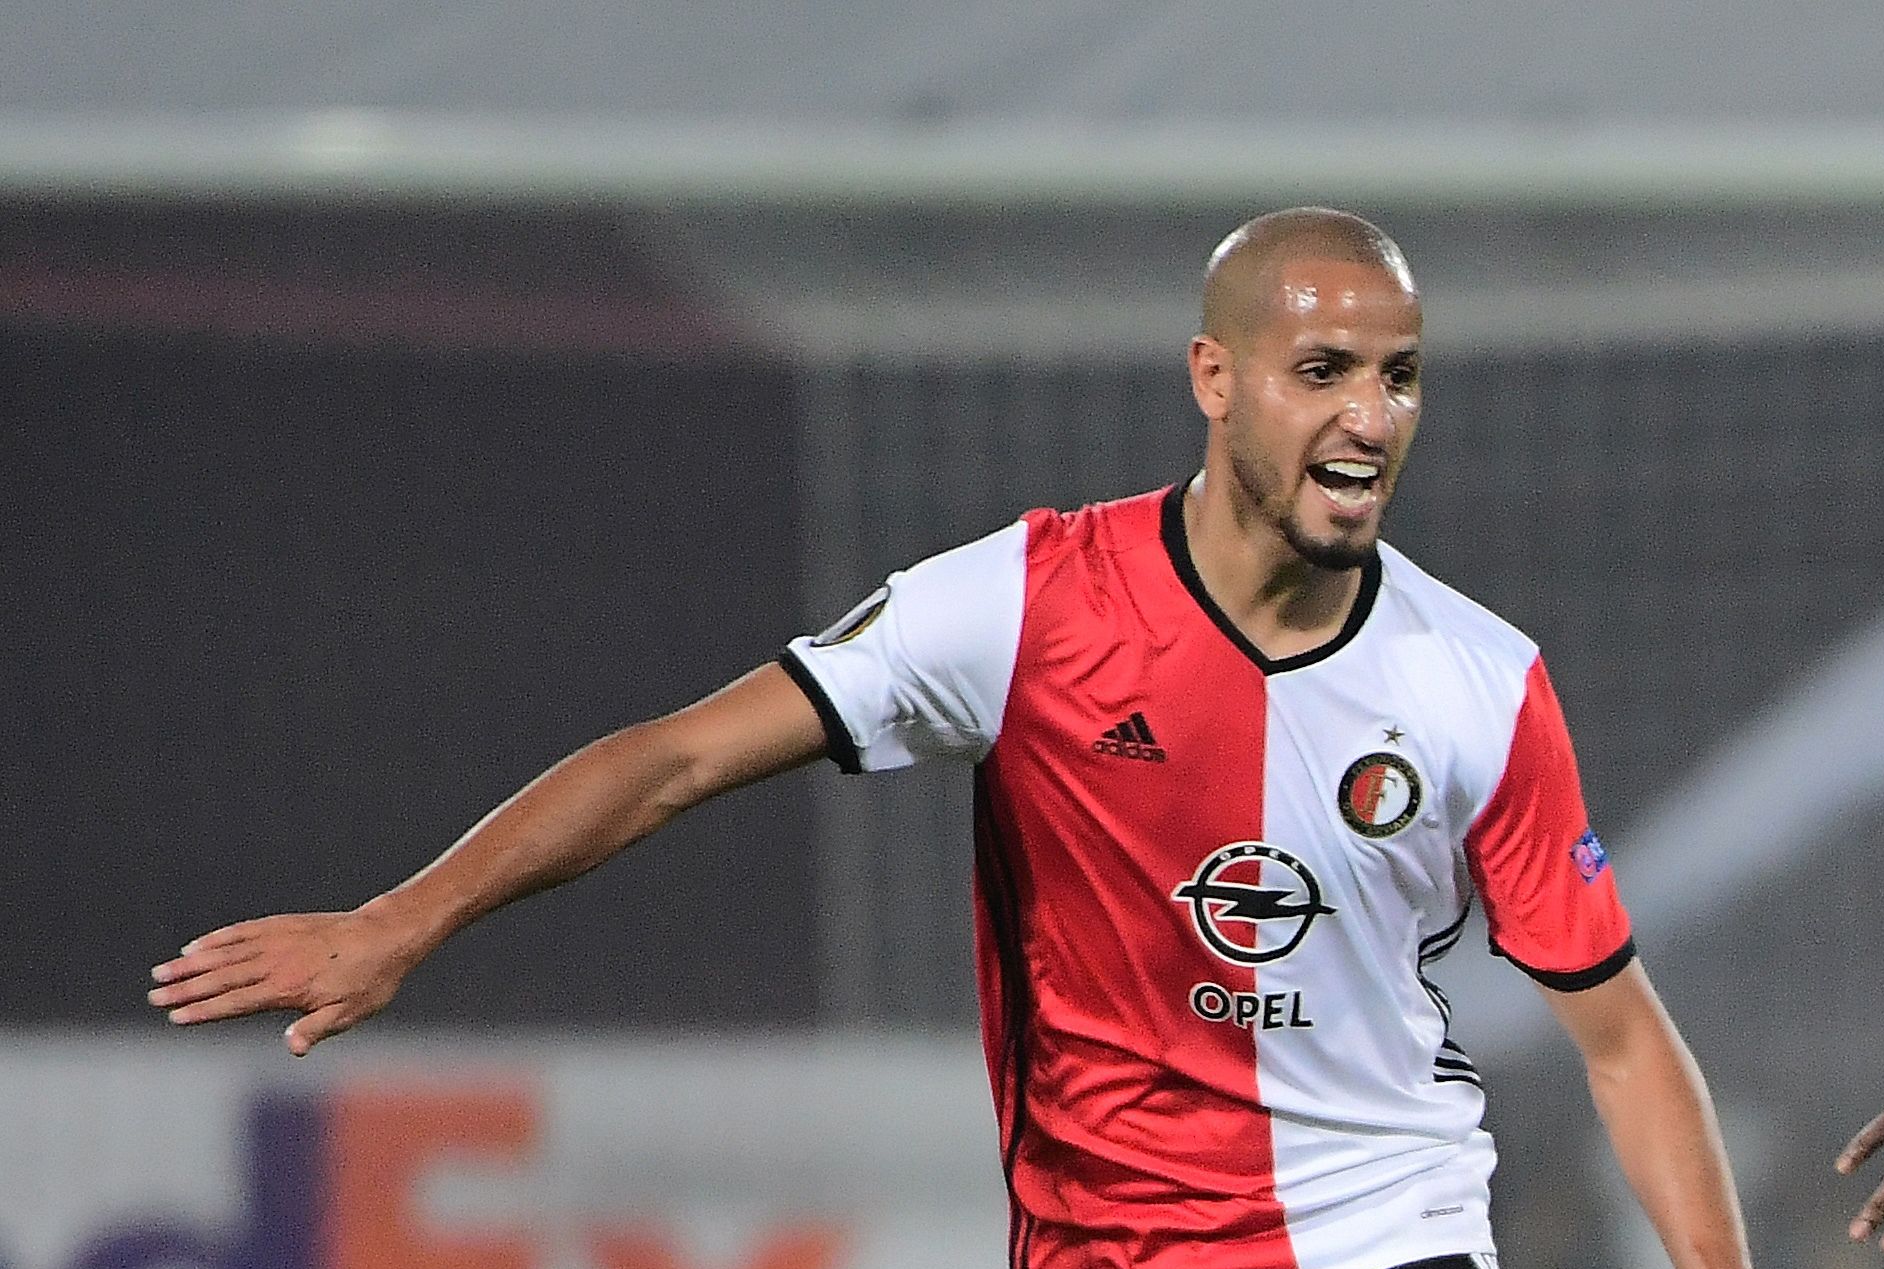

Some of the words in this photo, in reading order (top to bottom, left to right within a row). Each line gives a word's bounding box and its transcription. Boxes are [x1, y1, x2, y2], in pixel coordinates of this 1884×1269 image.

[1092, 740, 1166, 763] adidas
[1219, 846, 1301, 871] OPEL
[1192, 984, 1314, 1030] OPEL
